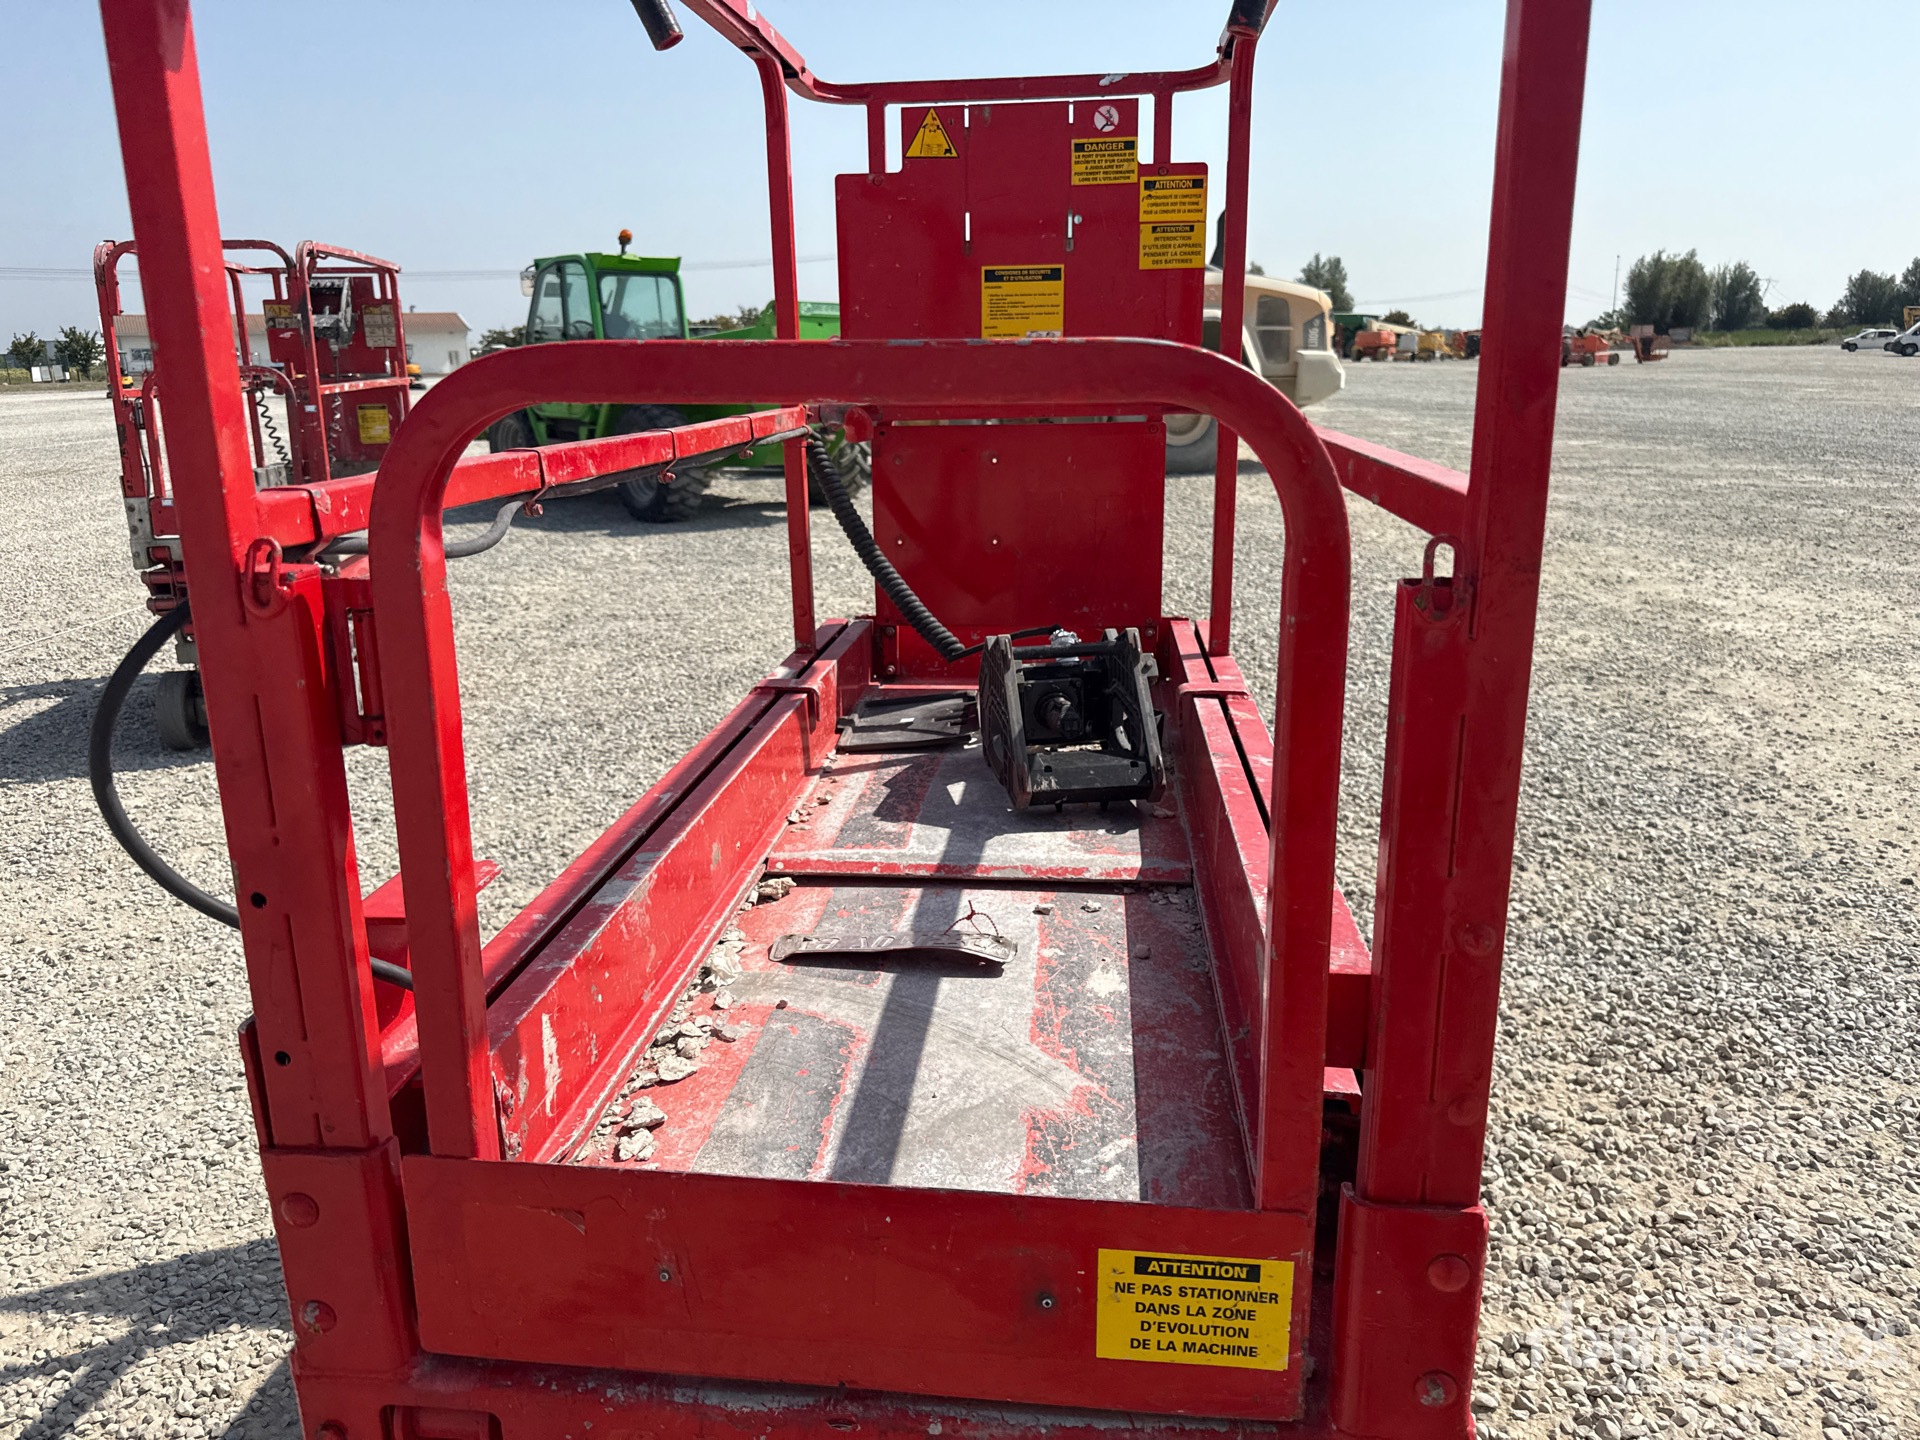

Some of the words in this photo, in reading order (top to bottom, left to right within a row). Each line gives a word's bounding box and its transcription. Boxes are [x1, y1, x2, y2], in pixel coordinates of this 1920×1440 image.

[1084, 143, 1124, 151] DANGER
[1155, 180, 1192, 189] ATTENTION
[1148, 1261, 1247, 1279] ATTENTION
[1115, 1282, 1135, 1294] NE
[1142, 1284, 1172, 1297] PAS
[1178, 1286, 1279, 1304] STATIONNER
[1135, 1302, 1180, 1316] DANS
[1186, 1305, 1206, 1317] LA
[1212, 1307, 1256, 1321] ZONE
[1140, 1321, 1249, 1339] D'EVOLUTION
[1130, 1338, 1150, 1350] DE
[1157, 1340, 1176, 1352] LA
[1183, 1342, 1258, 1357] MACHINE
